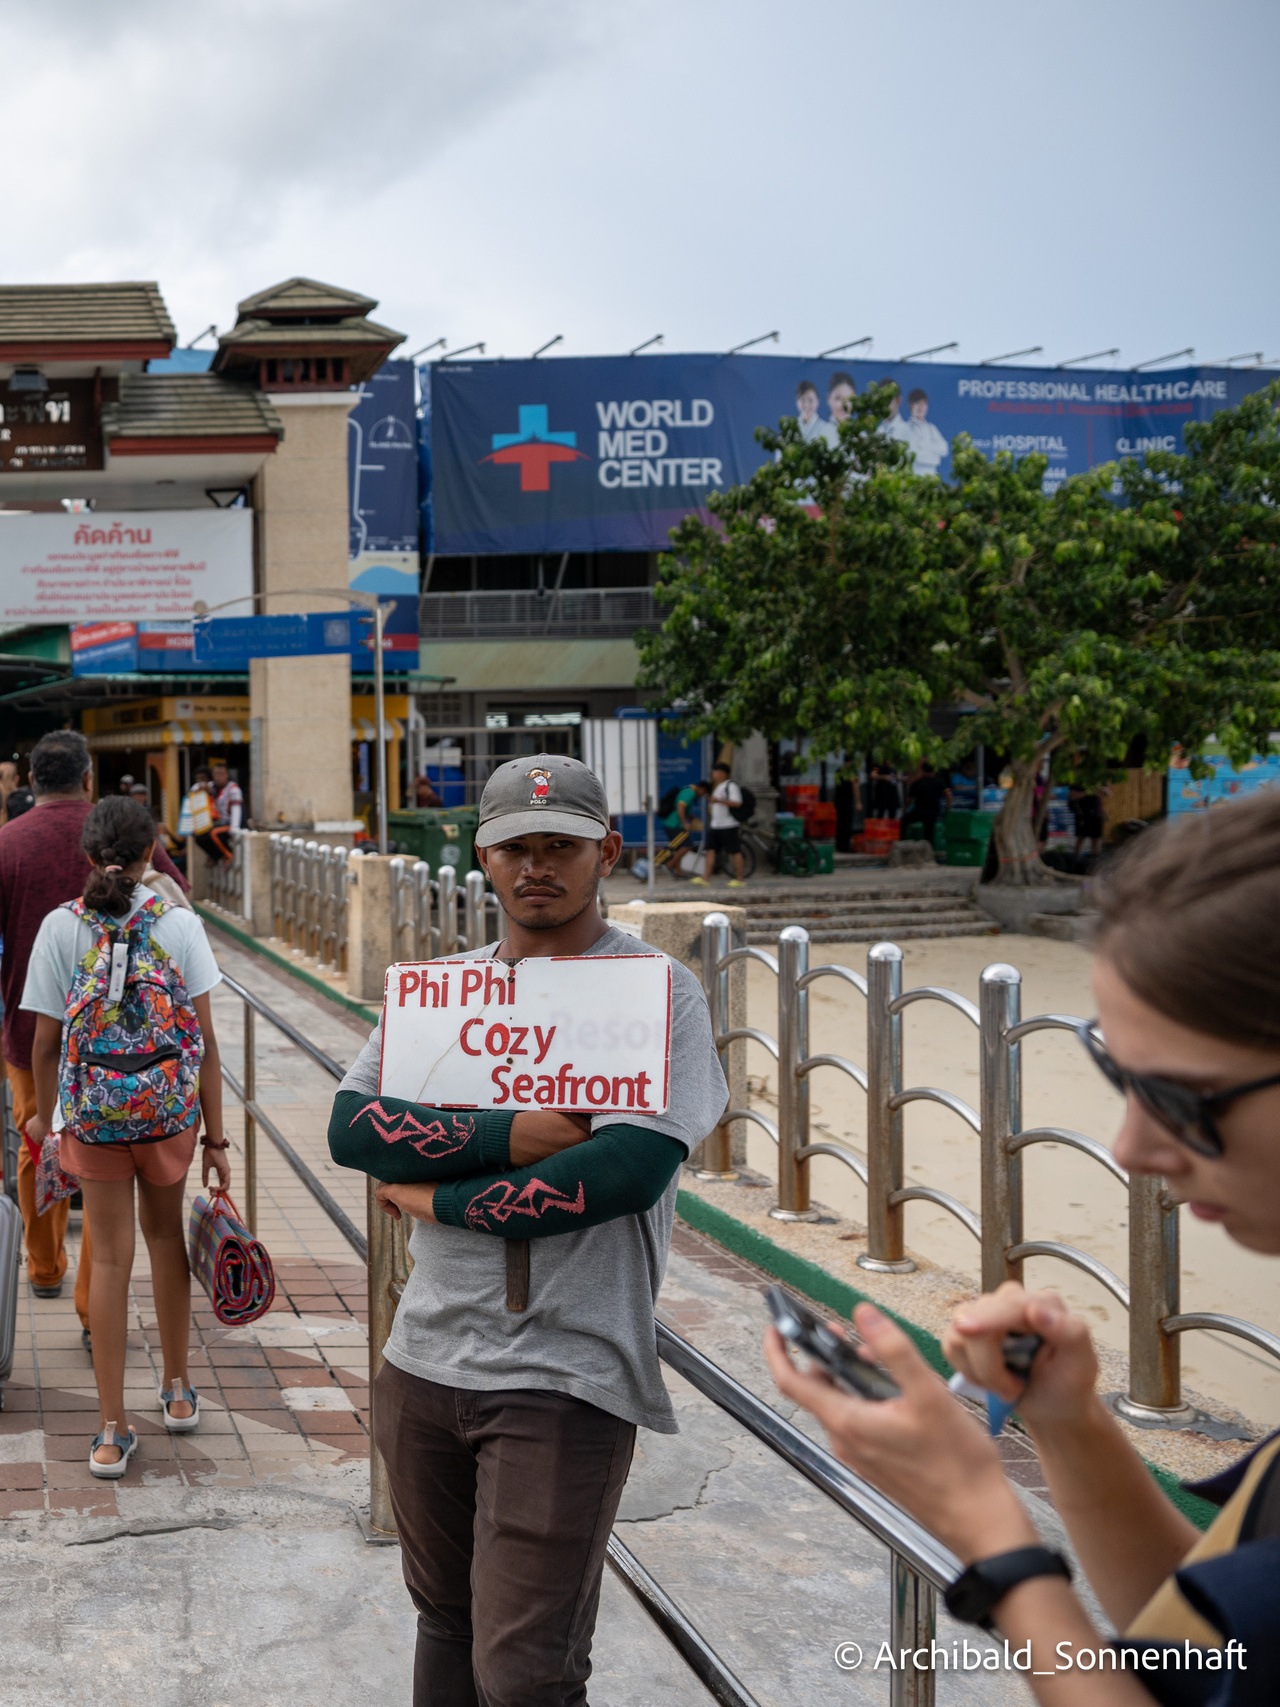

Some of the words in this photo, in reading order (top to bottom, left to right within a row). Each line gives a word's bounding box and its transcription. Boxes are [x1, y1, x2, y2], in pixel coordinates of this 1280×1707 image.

[958, 379, 1091, 401] PROFESSIONAL
[1095, 379, 1228, 402] HEALTHCARE
[596, 399, 715, 429] WORLD
[598, 430, 668, 459] MED
[992, 435, 1068, 451] HOSPITAL
[598, 458, 724, 488] CENTER
[73, 522, 152, 546] คัดค้าน
[398, 969, 449, 1008] Phi
[460, 966, 516, 1007] Phi
[459, 1018, 557, 1064] Cozy
[491, 1063, 652, 1108] Seafront
